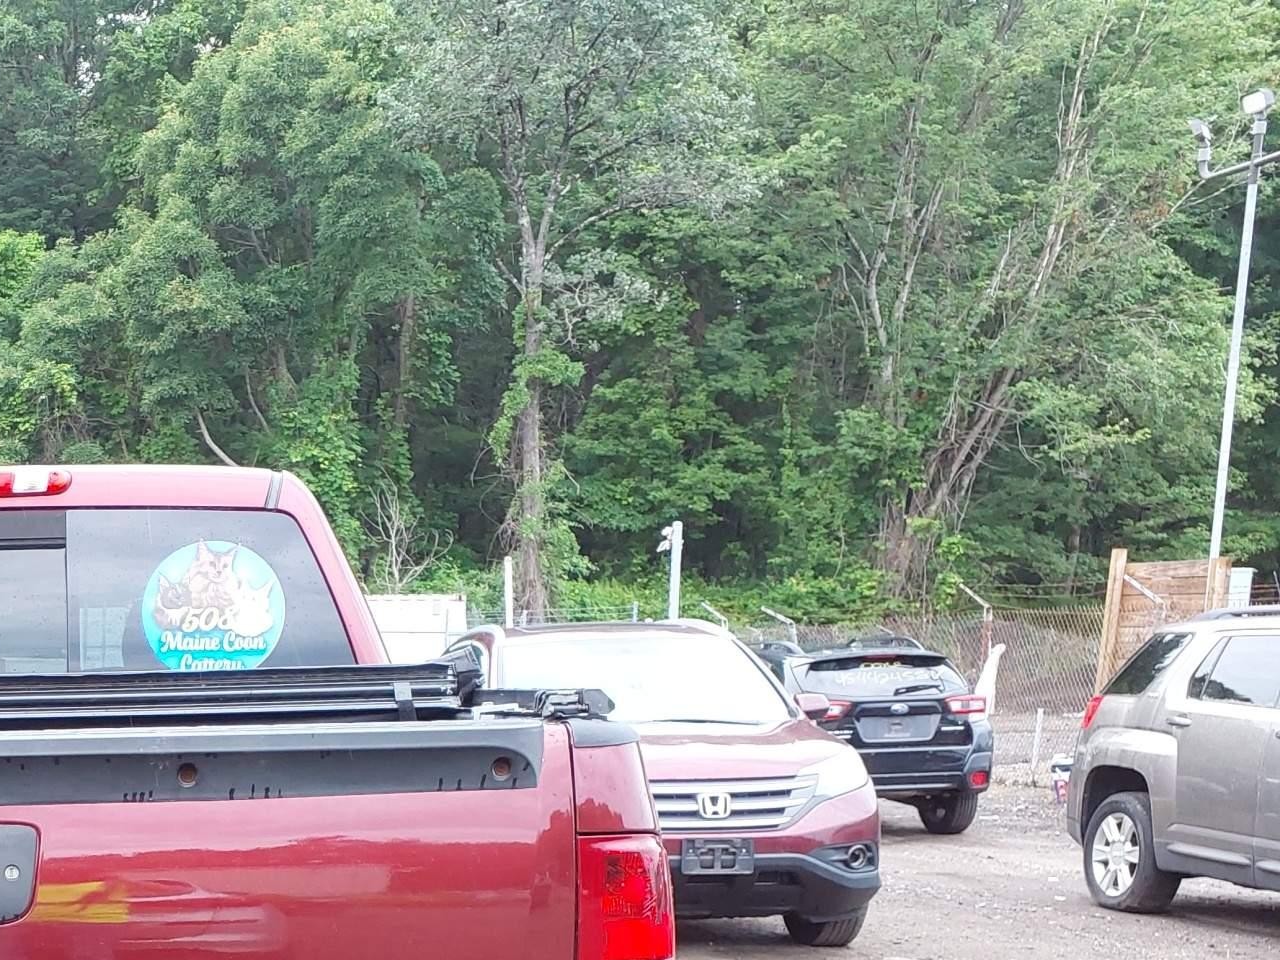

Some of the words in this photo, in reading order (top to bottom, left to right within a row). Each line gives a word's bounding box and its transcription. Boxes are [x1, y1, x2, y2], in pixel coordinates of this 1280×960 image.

[180, 605, 240, 633] 508
[160, 630, 221, 653] Maine
[222, 630, 267, 652] Coon
